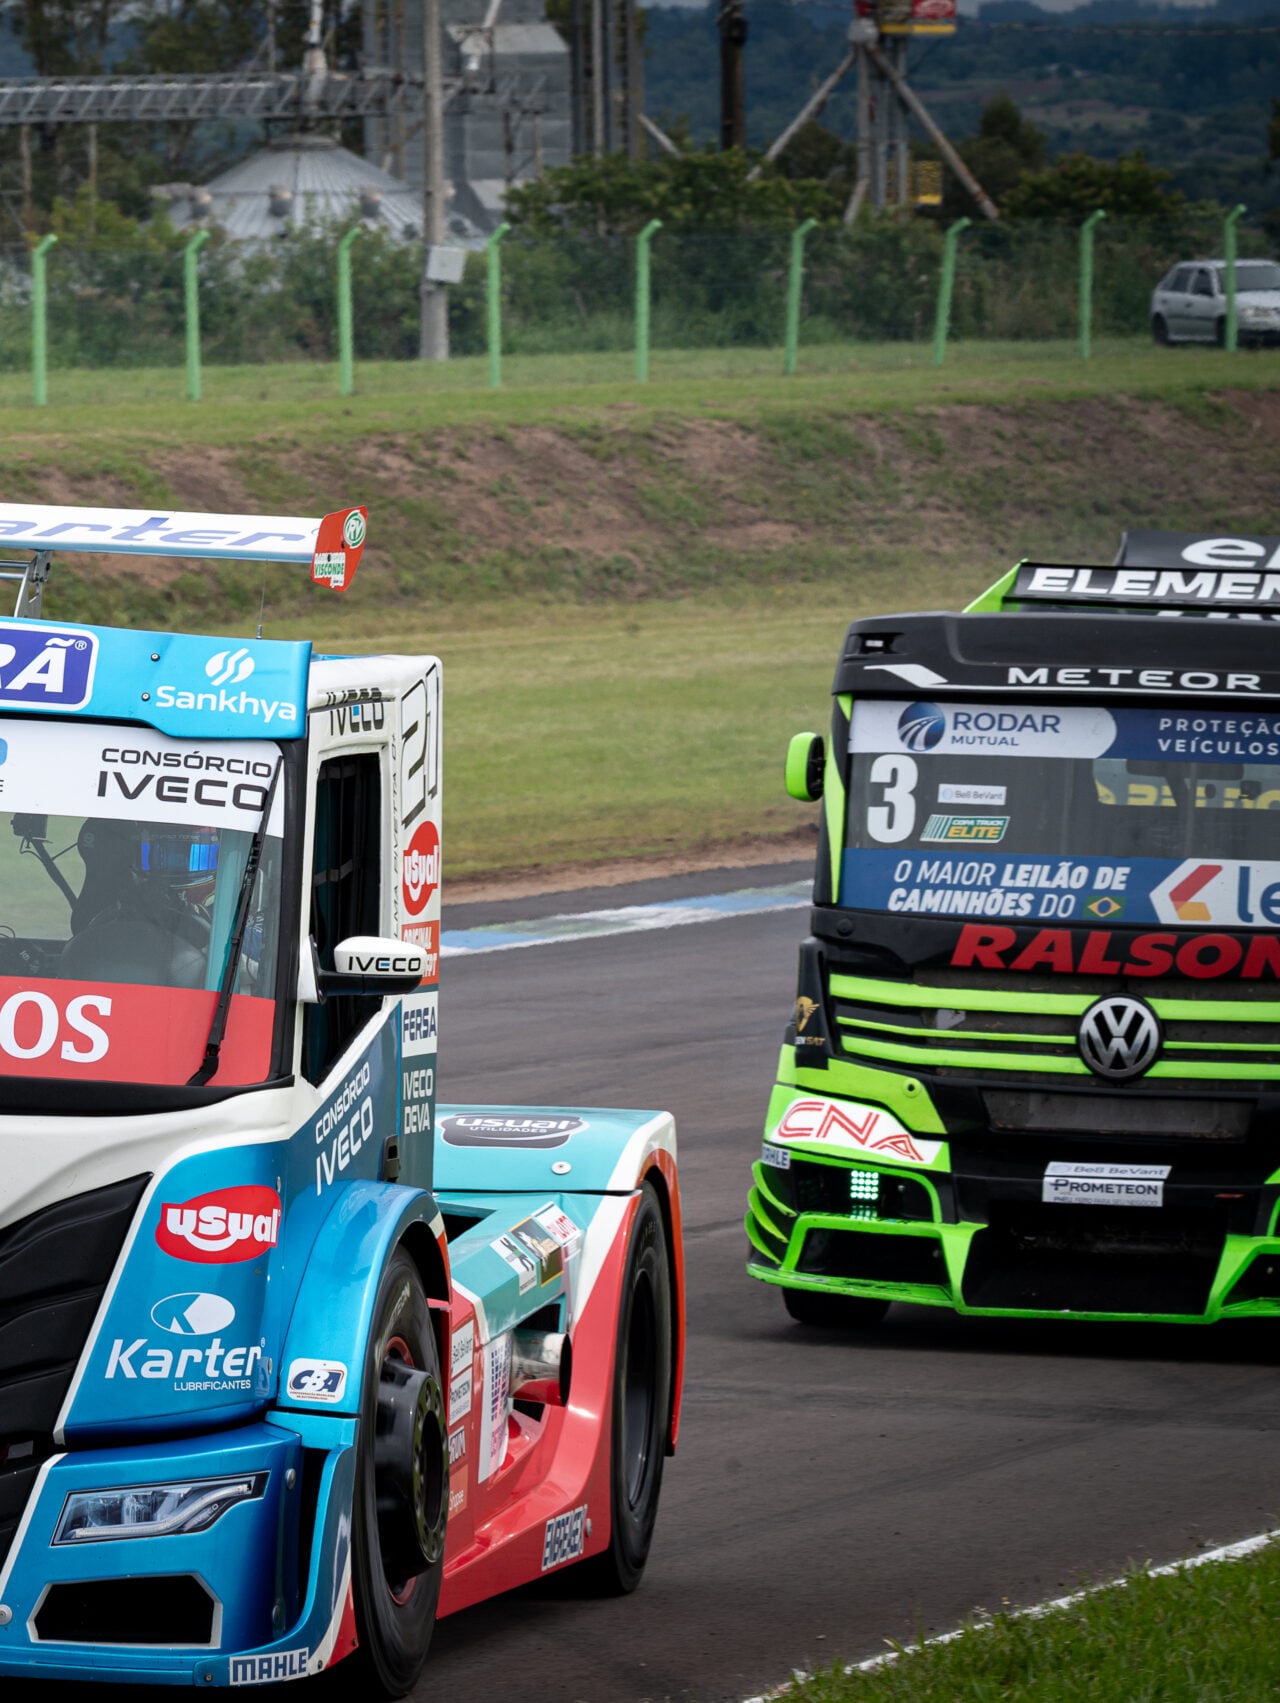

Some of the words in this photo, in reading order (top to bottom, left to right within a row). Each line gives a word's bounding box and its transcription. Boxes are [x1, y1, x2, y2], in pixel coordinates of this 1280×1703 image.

[314, 561, 345, 577] VISCONDE
[1006, 666, 1261, 691] METEOR
[155, 685, 297, 724] Sankhya
[951, 710, 1061, 734] RODAR
[950, 735, 1020, 748] MUTUAL
[1157, 736, 1280, 756] VEÍCULOS
[101, 747, 272, 778] CONSÓRCIO
[97, 770, 269, 813] IVECO
[866, 753, 919, 844] 3
[946, 825, 1002, 839] ELITE
[403, 845, 439, 896] usual
[893, 860, 912, 883] O
[915, 860, 997, 887] MAIOR
[1000, 861, 1089, 890] LEILÃO
[1092, 866, 1132, 892] DE
[887, 887, 1033, 917] CAMINHÕES
[1038, 892, 1077, 919] DO
[348, 956, 422, 972] IVECO
[402, 1005, 438, 1044] FERSA
[402, 1068, 434, 1101] IVECO
[315, 1060, 371, 1145] CONSÓRCIO
[403, 1102, 431, 1135] DEVA
[455, 1117, 570, 1130] usual
[777, 1100, 926, 1163] CNA
[315, 1095, 374, 1197] IVECO
[1050, 1178, 1159, 1196] PROMETEON
[1108, 1167, 1166, 1176] BeVant
[166, 1205, 279, 1247] usual
[104, 1337, 262, 1379] Karter
[173, 1379, 252, 1392] LUBRIFICANTES
[291, 1368, 342, 1393] CBA
[231, 1650, 308, 1683] MAHLE
